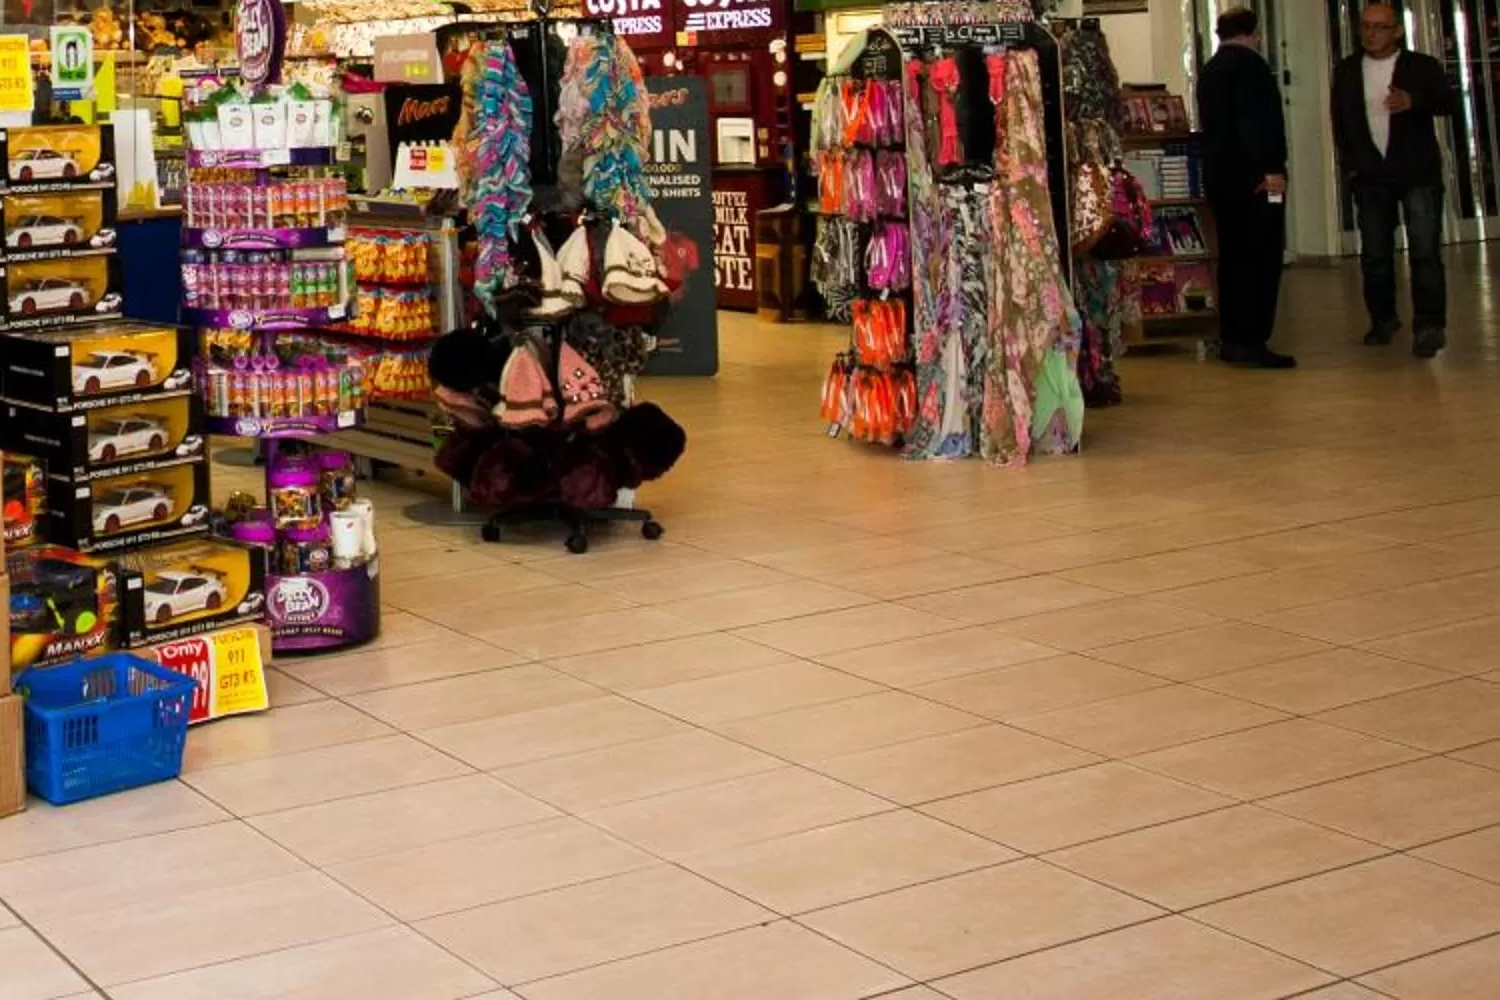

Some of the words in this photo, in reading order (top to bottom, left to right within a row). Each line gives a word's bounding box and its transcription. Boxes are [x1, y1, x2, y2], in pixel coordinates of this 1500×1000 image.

[613, 16, 663, 35] XPRESS
[706, 8, 772, 30] EXPRESS
[397, 96, 450, 126] Mars
[654, 129, 697, 163] IN
[650, 174, 700, 186] NALISED
[662, 187, 701, 198] SHIRTS
[163, 643, 203, 659] Only
[227, 649, 245, 663] 911
[219, 673, 240, 689] GT3
[244, 670, 257, 684] RS
